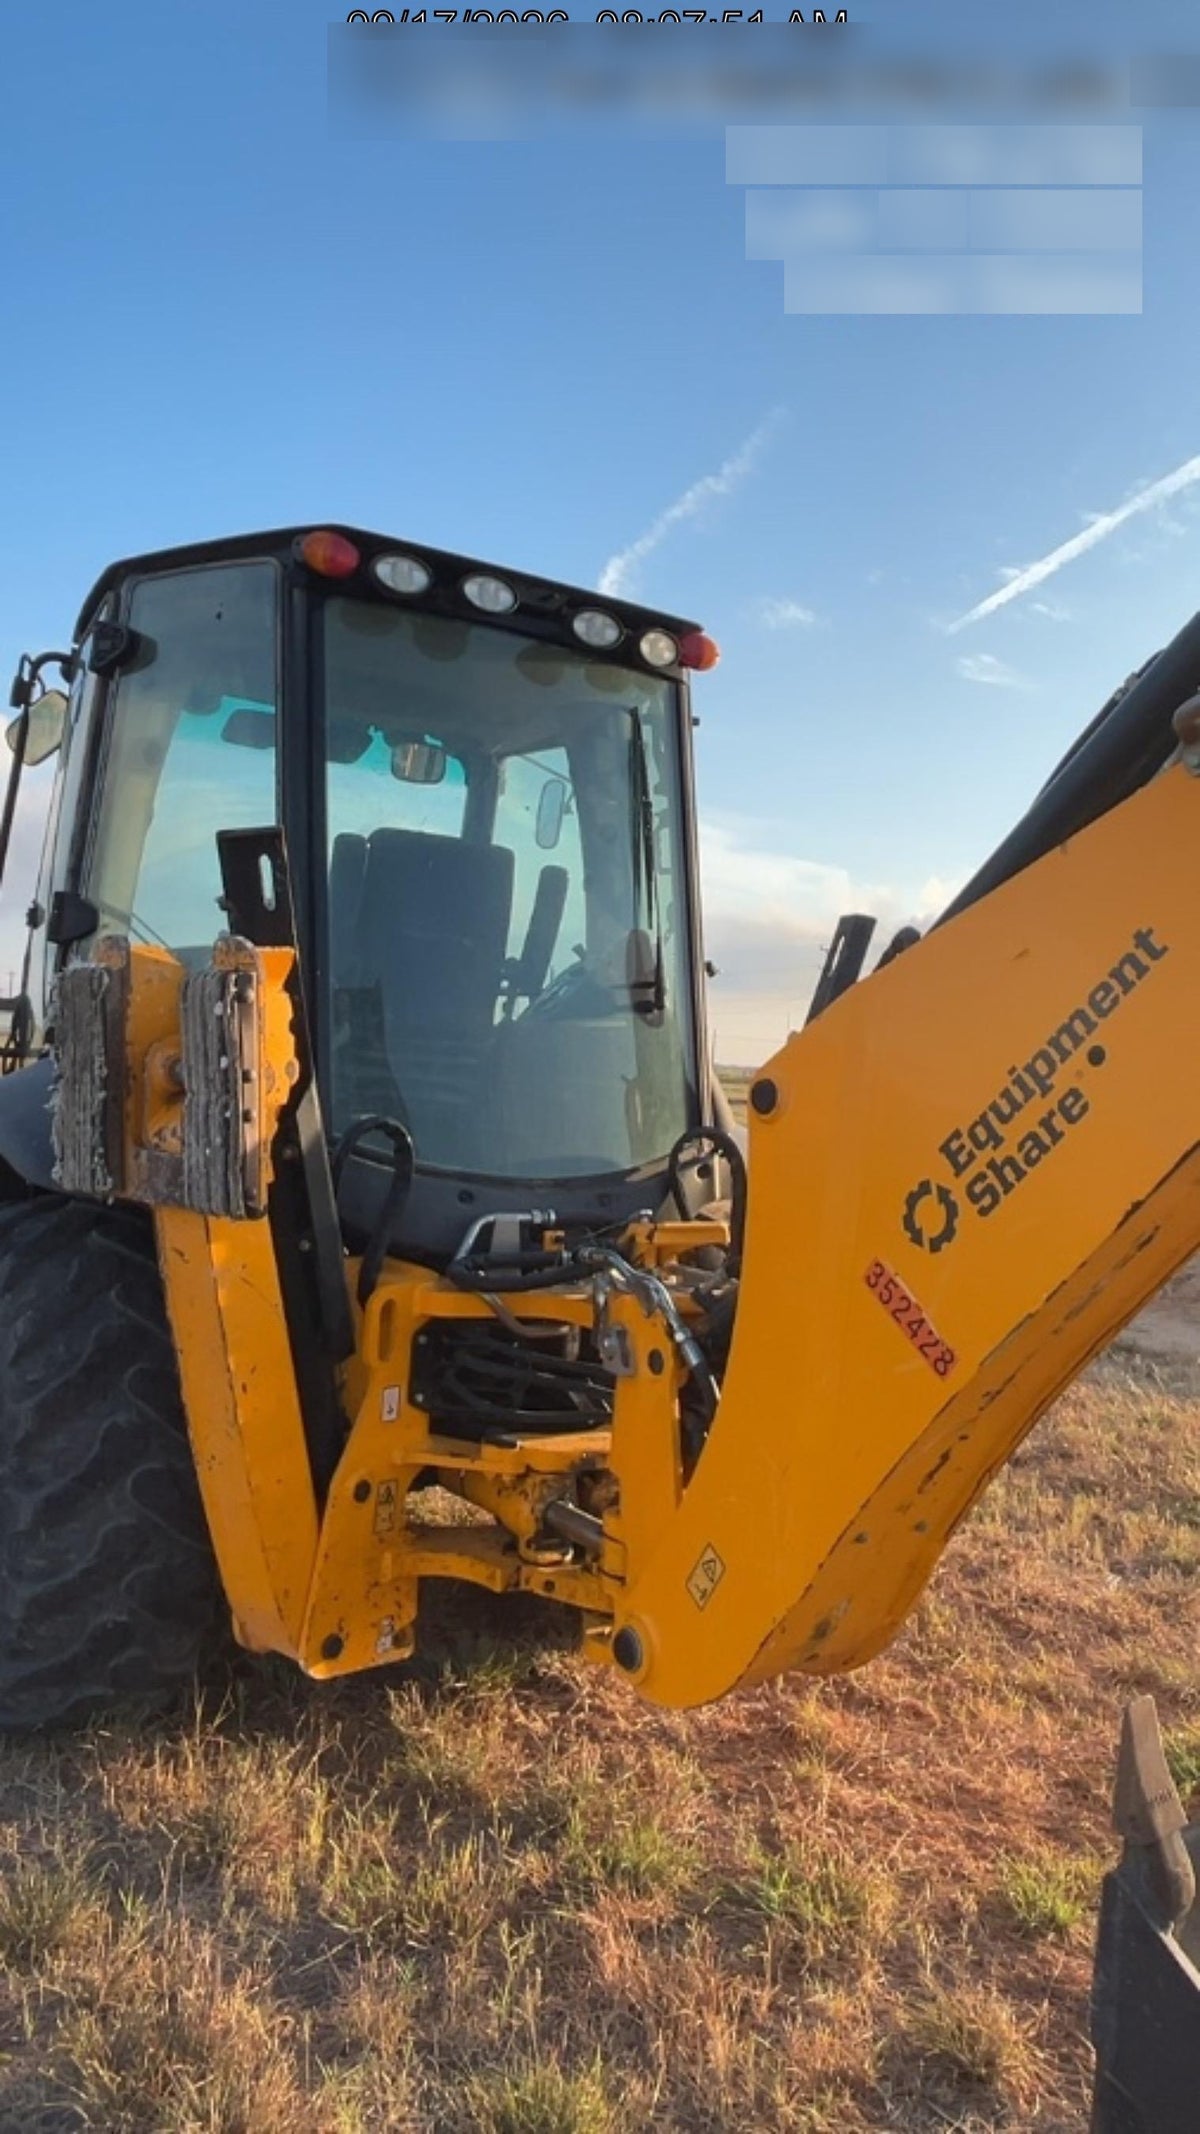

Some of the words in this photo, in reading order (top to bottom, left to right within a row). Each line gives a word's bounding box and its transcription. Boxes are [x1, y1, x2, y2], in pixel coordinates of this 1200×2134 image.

[938, 924, 1169, 1177] Equipment
[965, 1087, 1090, 1217] Share
[865, 1261, 955, 1376] 352428
